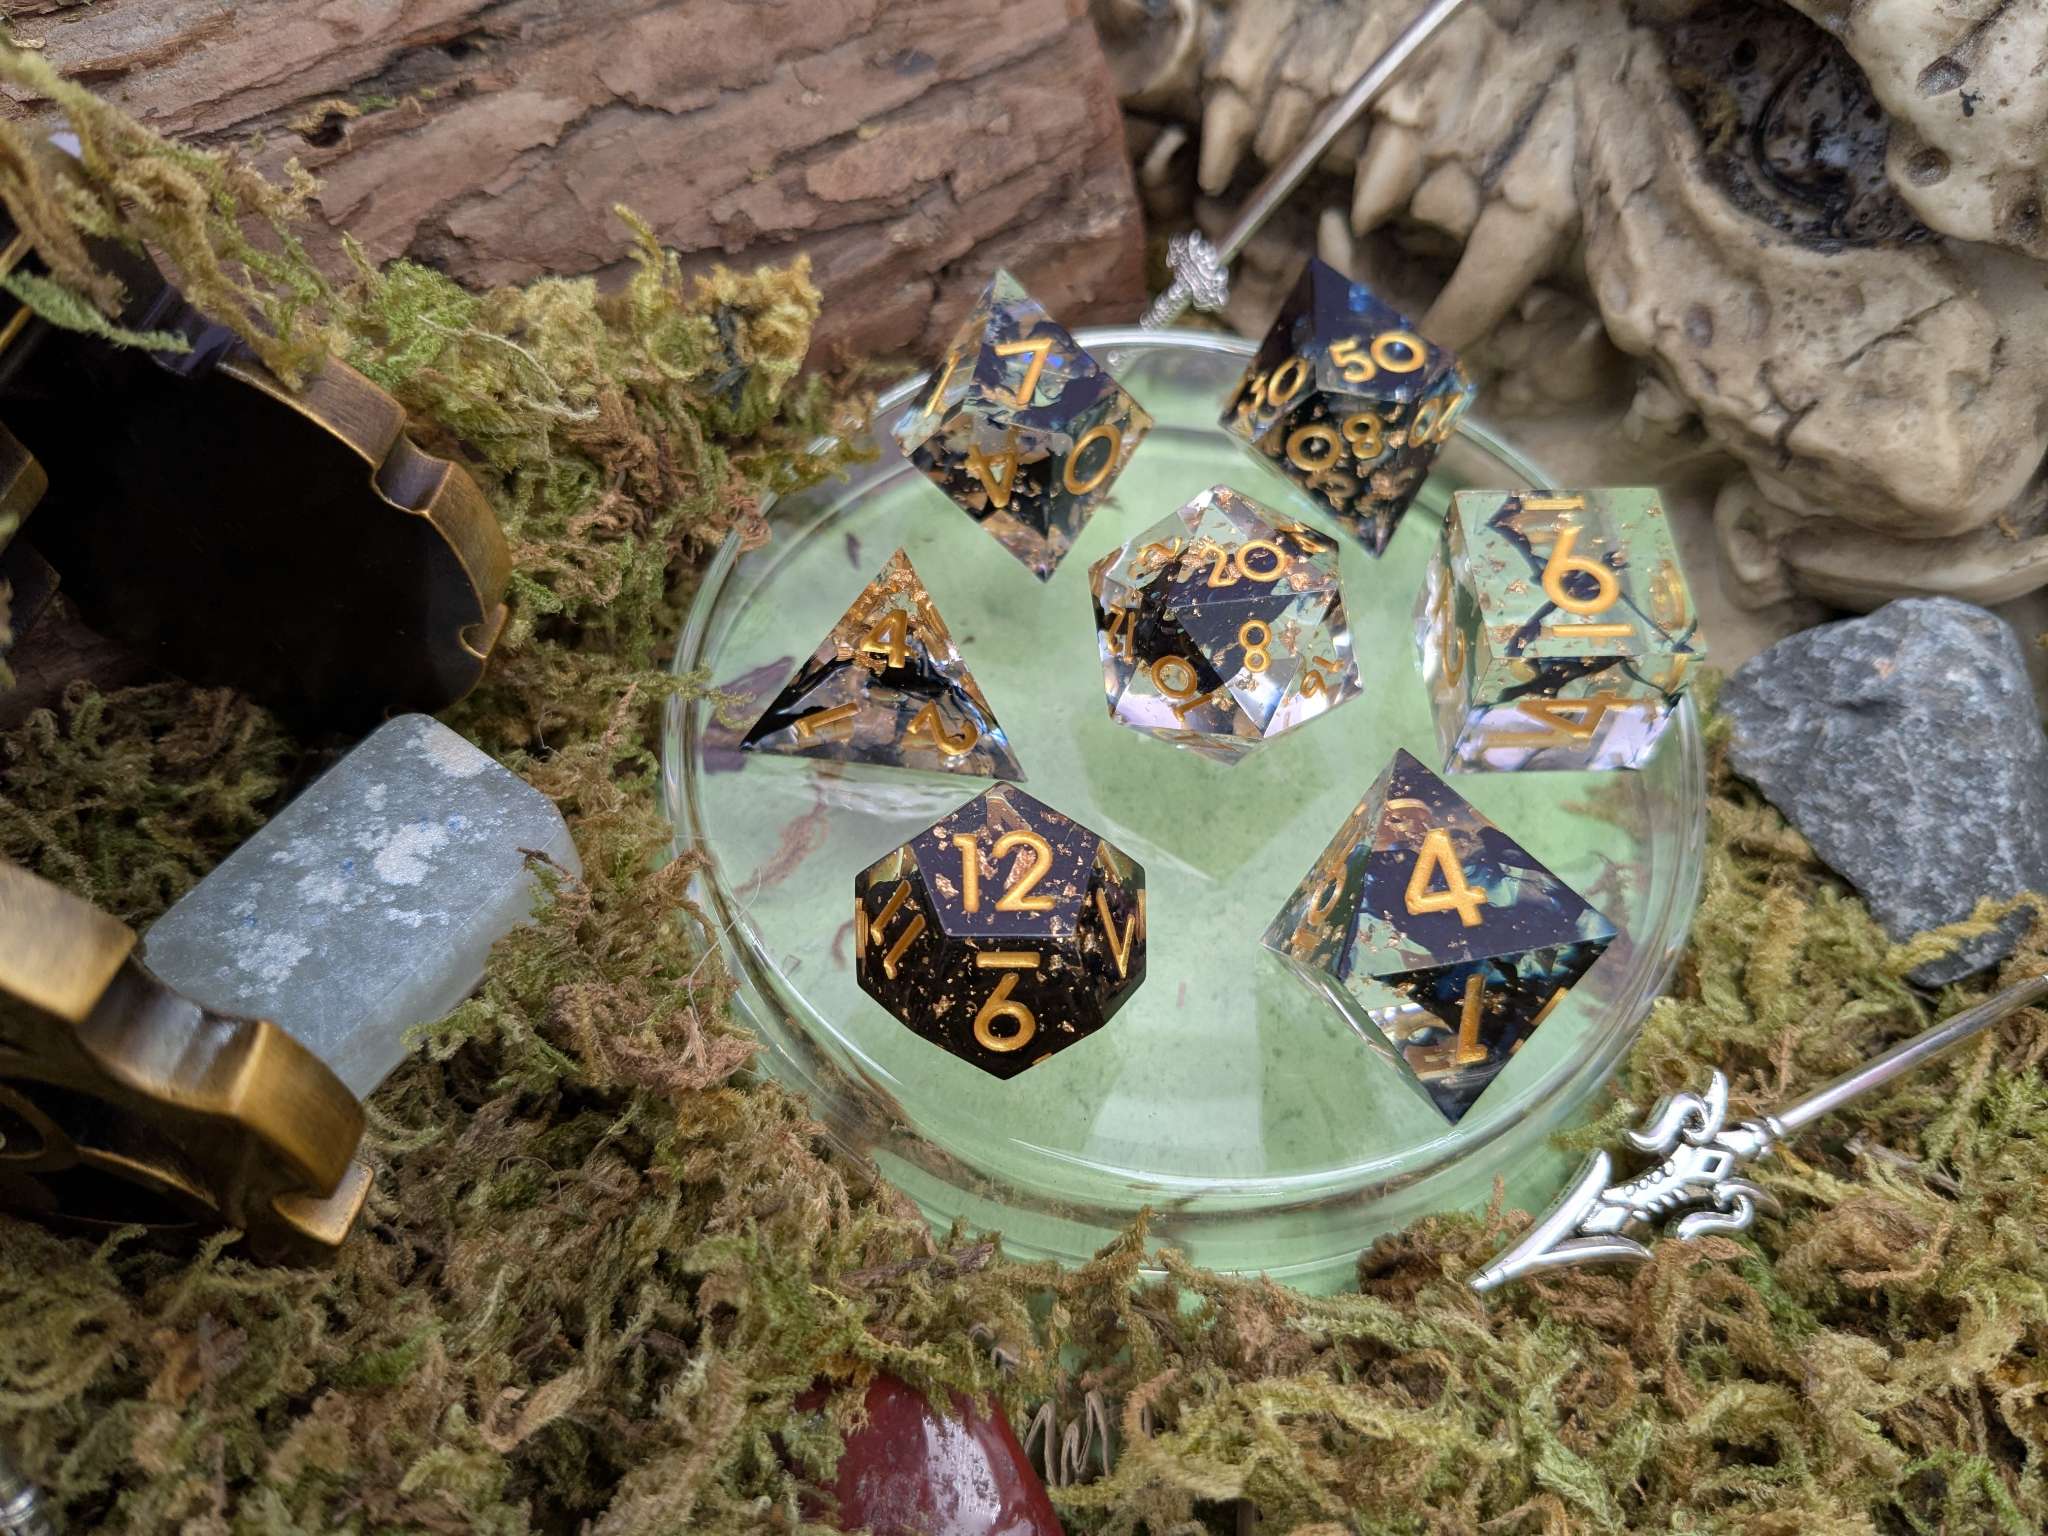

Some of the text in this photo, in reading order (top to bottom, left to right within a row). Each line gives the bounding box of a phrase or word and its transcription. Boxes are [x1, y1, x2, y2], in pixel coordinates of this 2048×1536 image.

[995, 338, 1053, 407] 7
[1330, 331, 1426, 383] 50
[1198, 539, 1288, 588] 20
[859, 609, 912, 668] 4
[1237, 619, 1273, 673] 8
[906, 700, 979, 756] 2
[953, 830, 1055, 913] 12
[1405, 827, 1488, 928] 4
[1455, 974, 1488, 1065] 1
